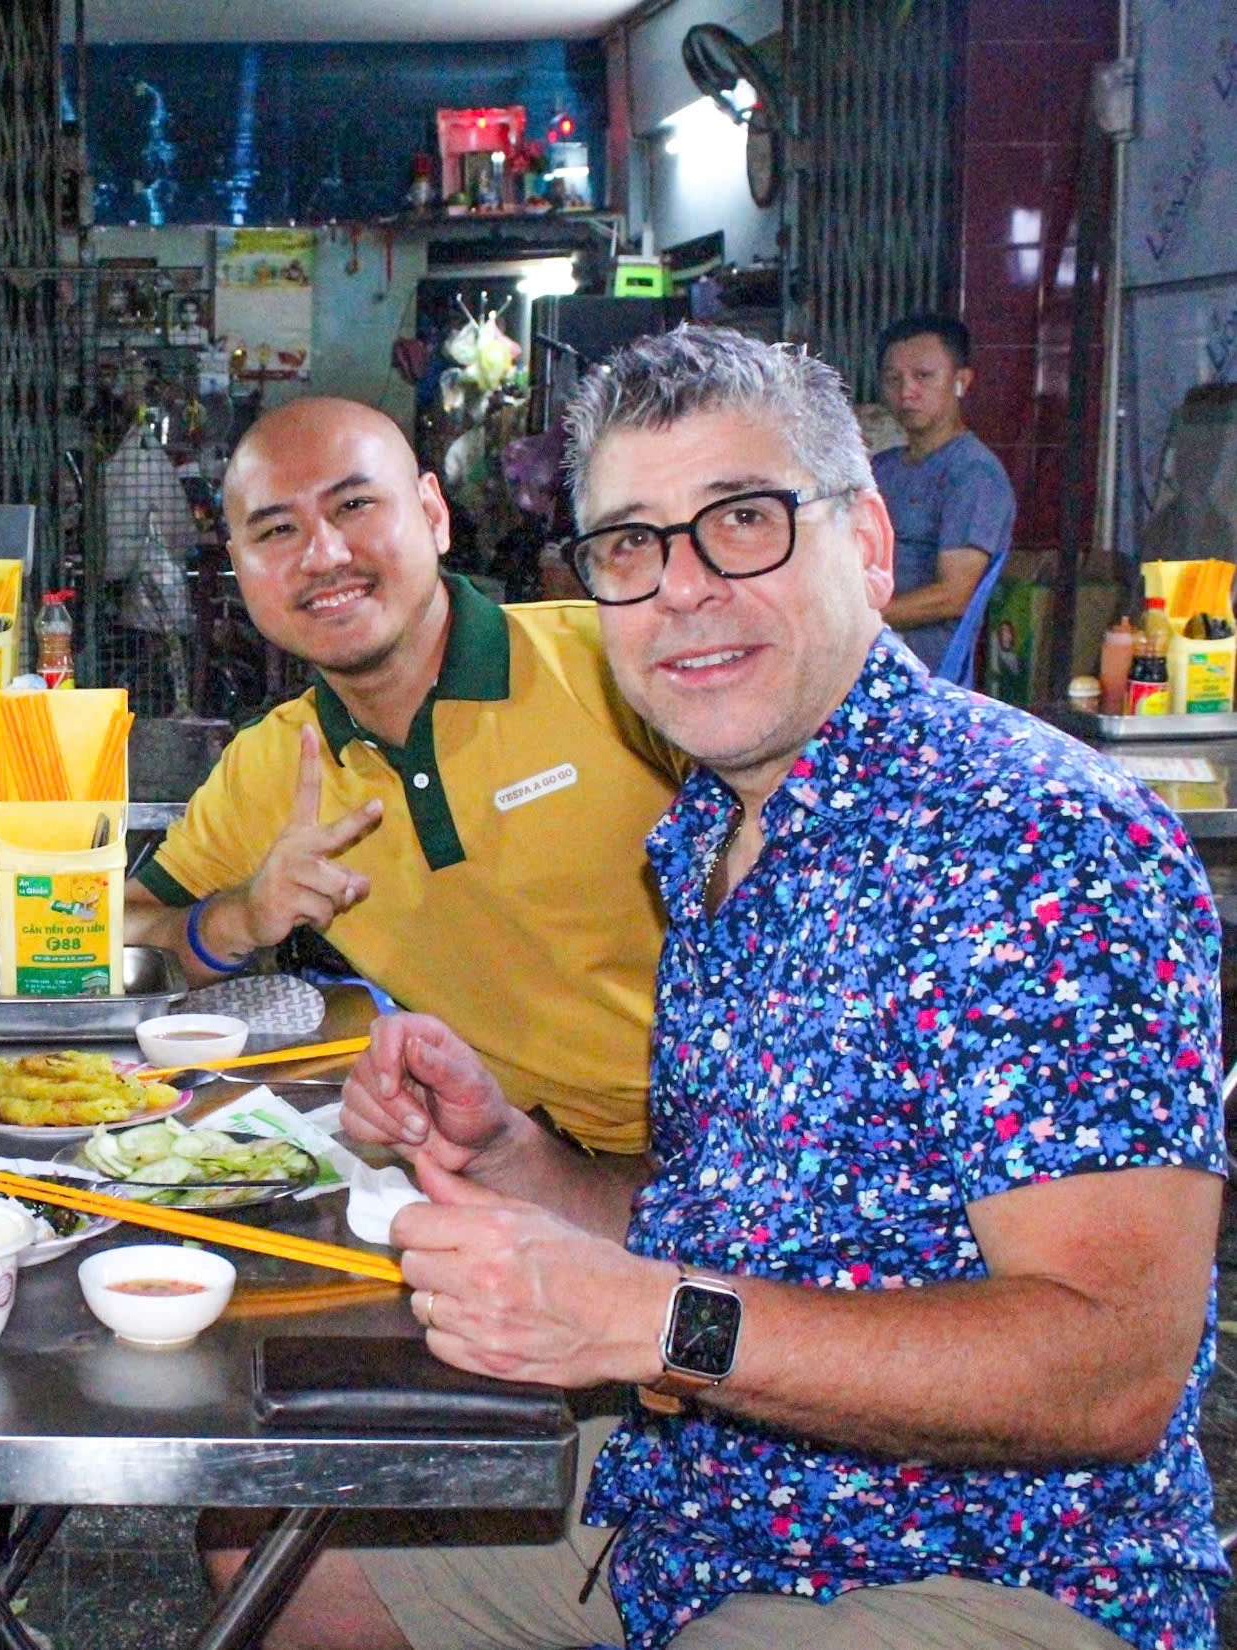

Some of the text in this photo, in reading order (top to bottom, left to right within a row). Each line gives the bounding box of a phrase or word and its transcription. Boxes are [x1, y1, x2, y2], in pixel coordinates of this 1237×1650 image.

[498, 768, 573, 804] VESPA A GO GO
